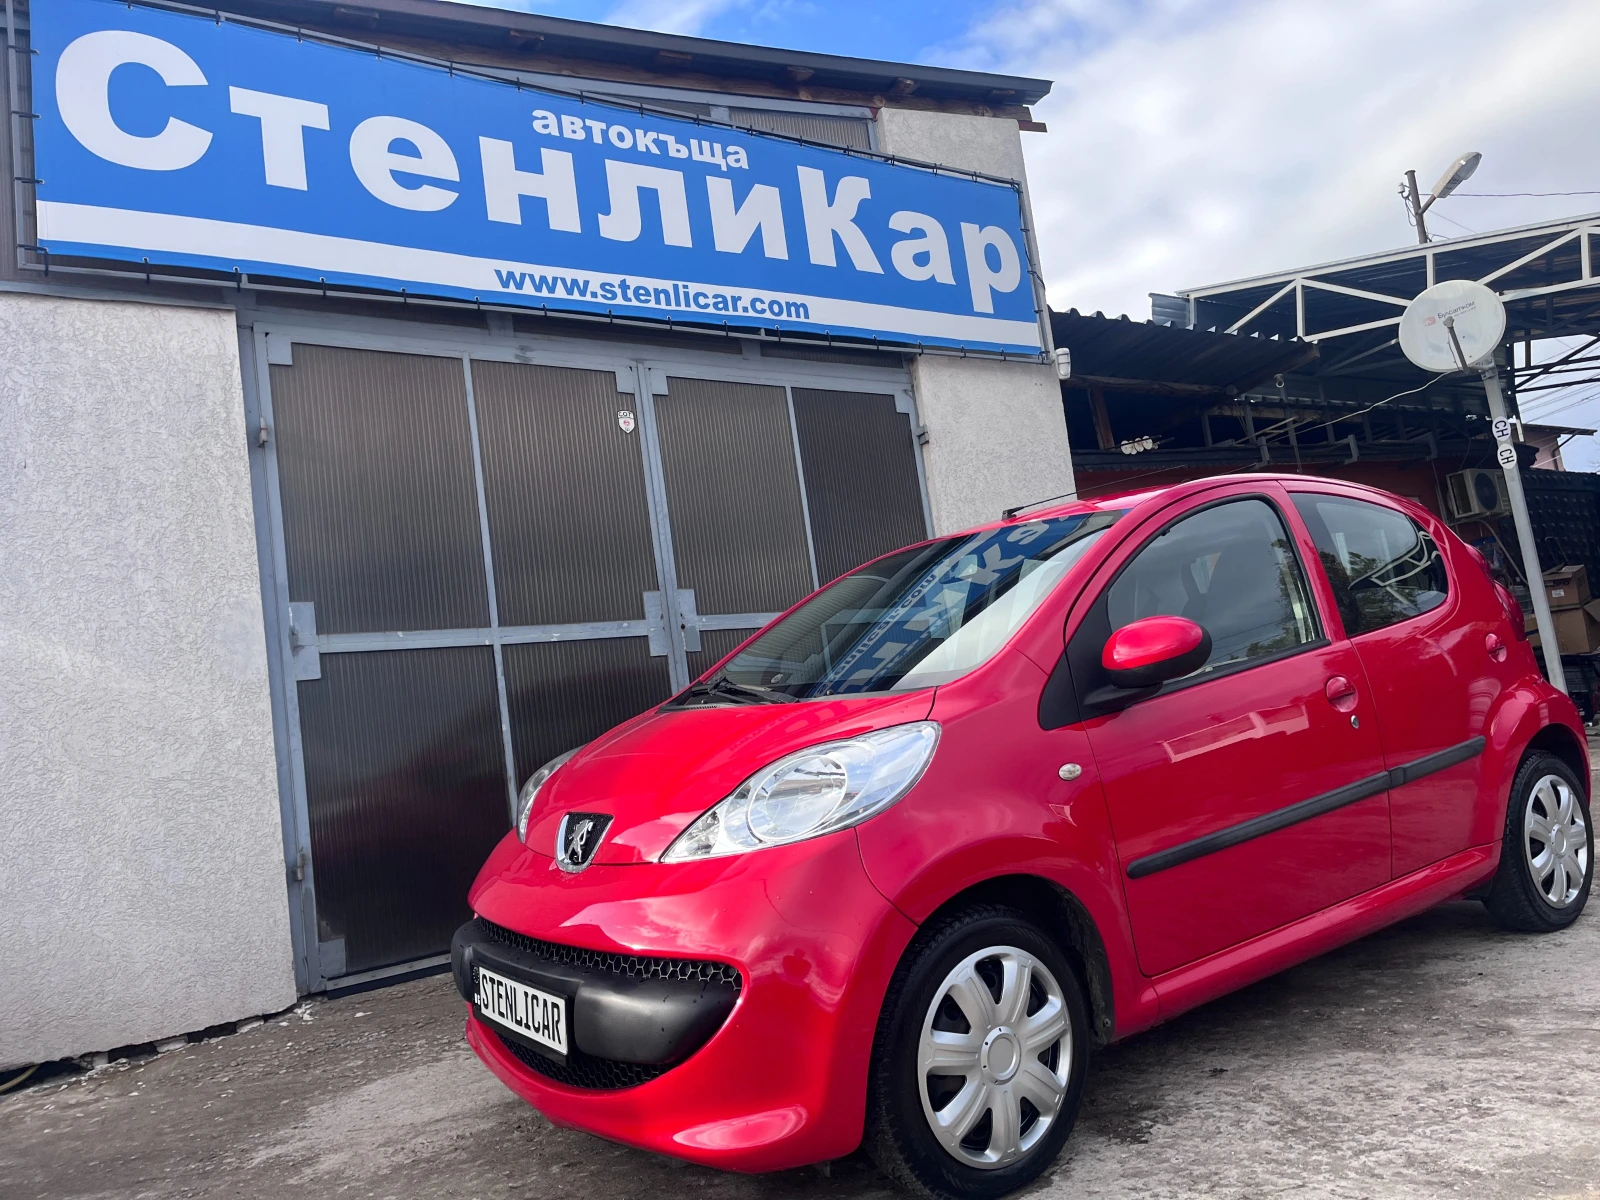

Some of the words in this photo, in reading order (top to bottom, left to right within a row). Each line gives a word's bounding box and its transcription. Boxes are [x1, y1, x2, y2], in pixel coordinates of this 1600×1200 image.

[532, 109, 749, 172] автокъща
[55, 29, 1022, 314] СтенлиКар
[494, 268, 810, 321] www.stenlicar.com
[1494, 420, 1509, 438] CH
[1499, 448, 1515, 465] CH
[481, 973, 562, 1045] STENLICAR
